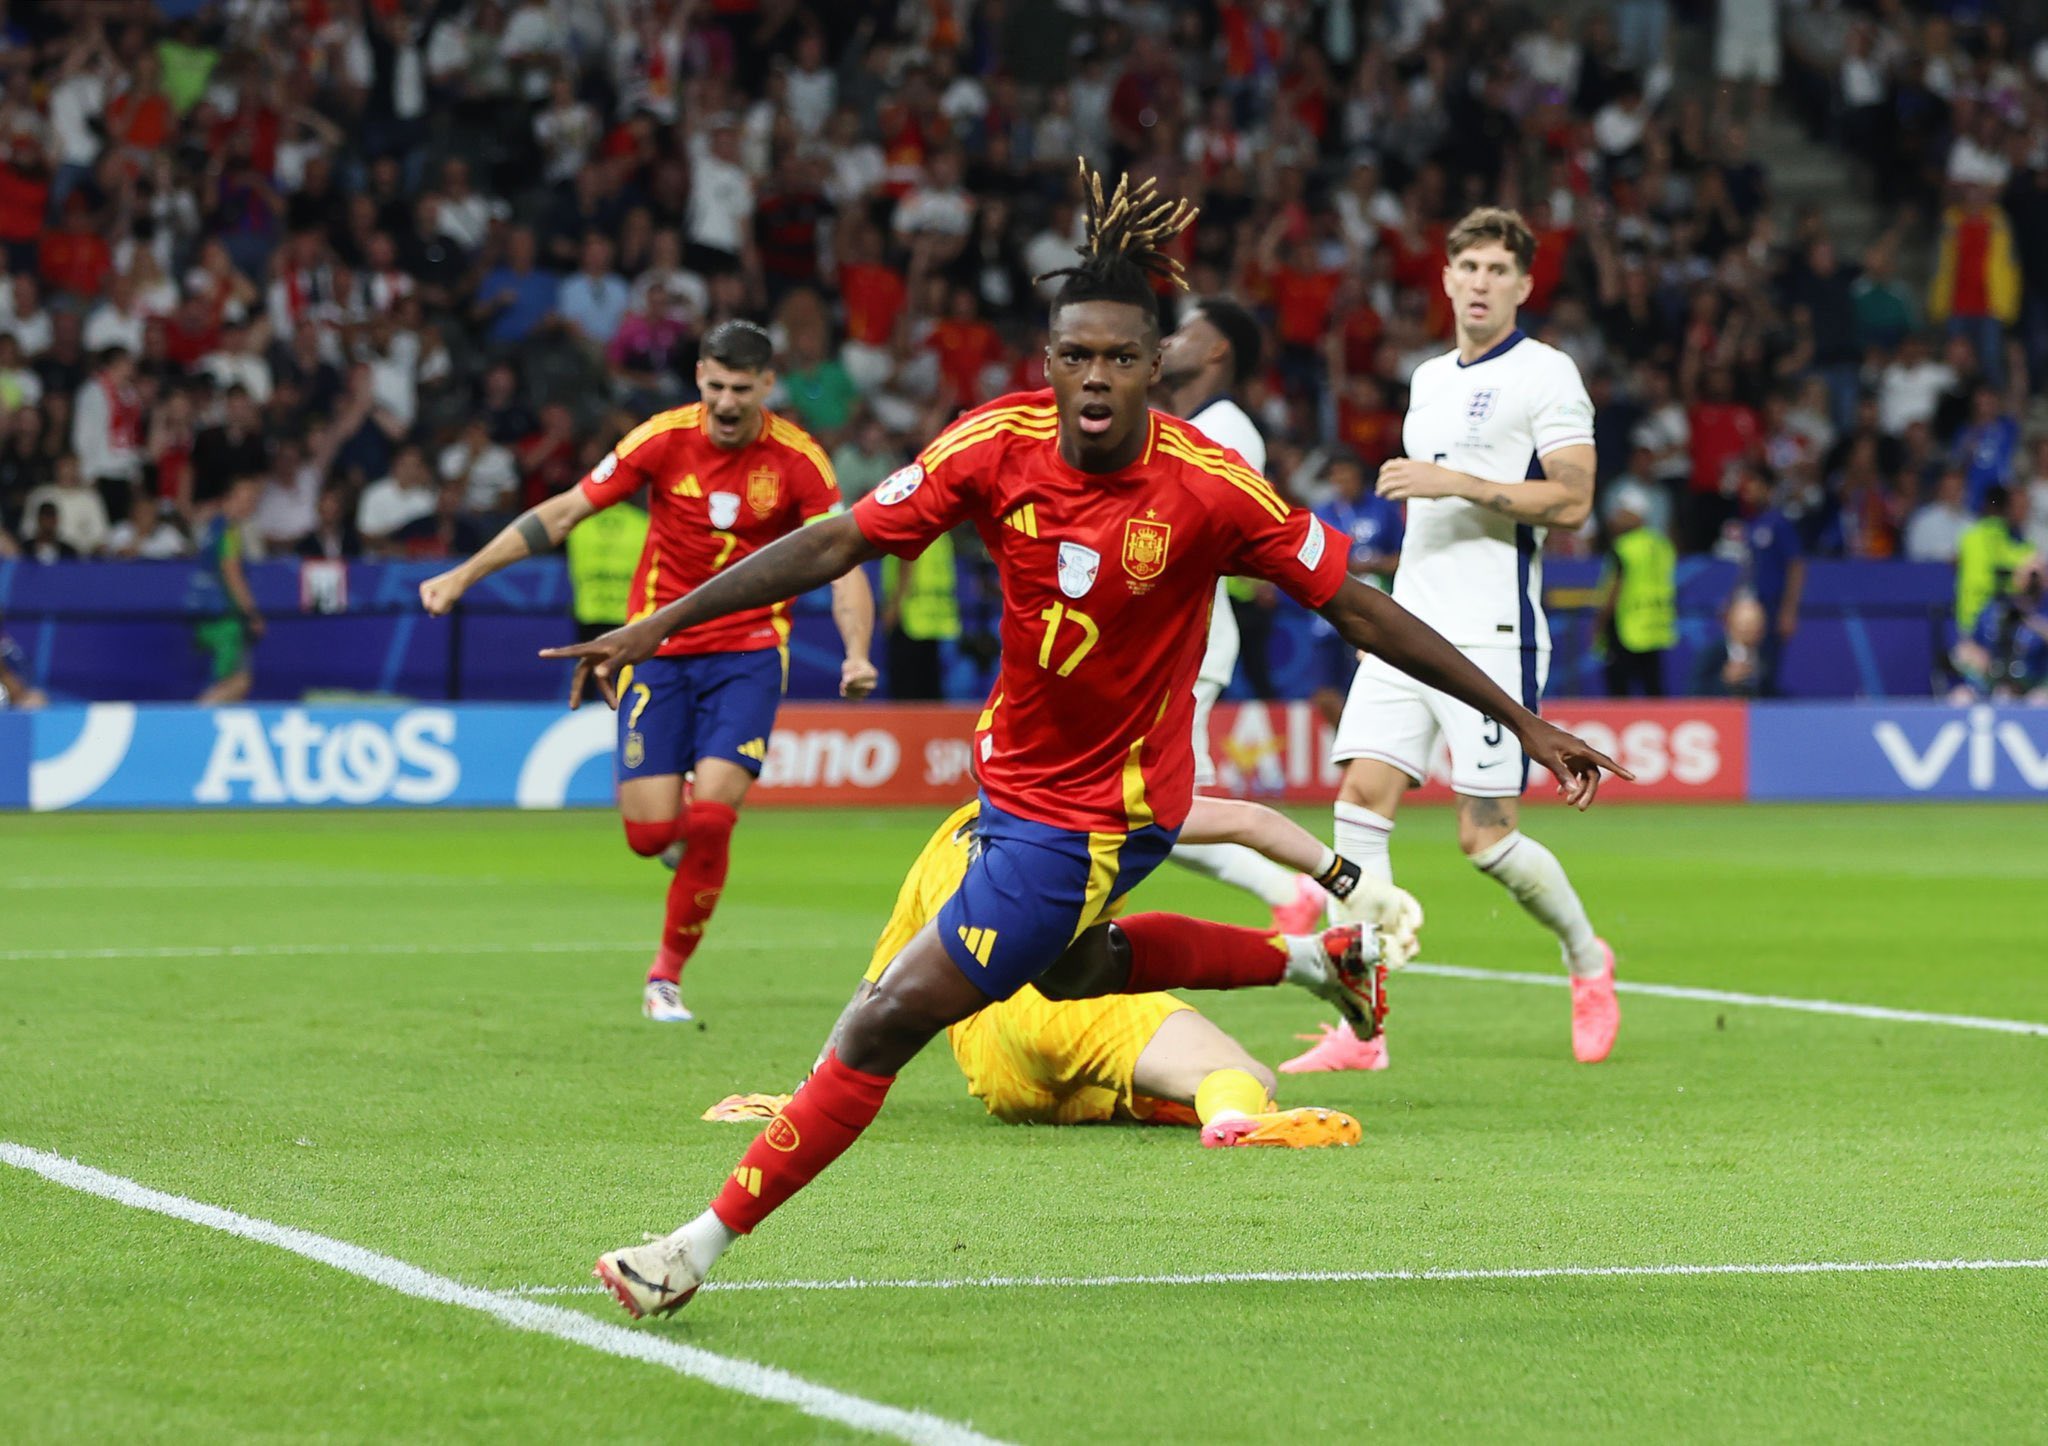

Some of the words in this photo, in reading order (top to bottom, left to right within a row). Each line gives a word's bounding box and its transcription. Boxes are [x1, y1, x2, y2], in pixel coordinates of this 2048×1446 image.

[711, 530, 738, 571] 7
[1038, 600, 1100, 678] 17
[628, 683, 652, 729] 7
